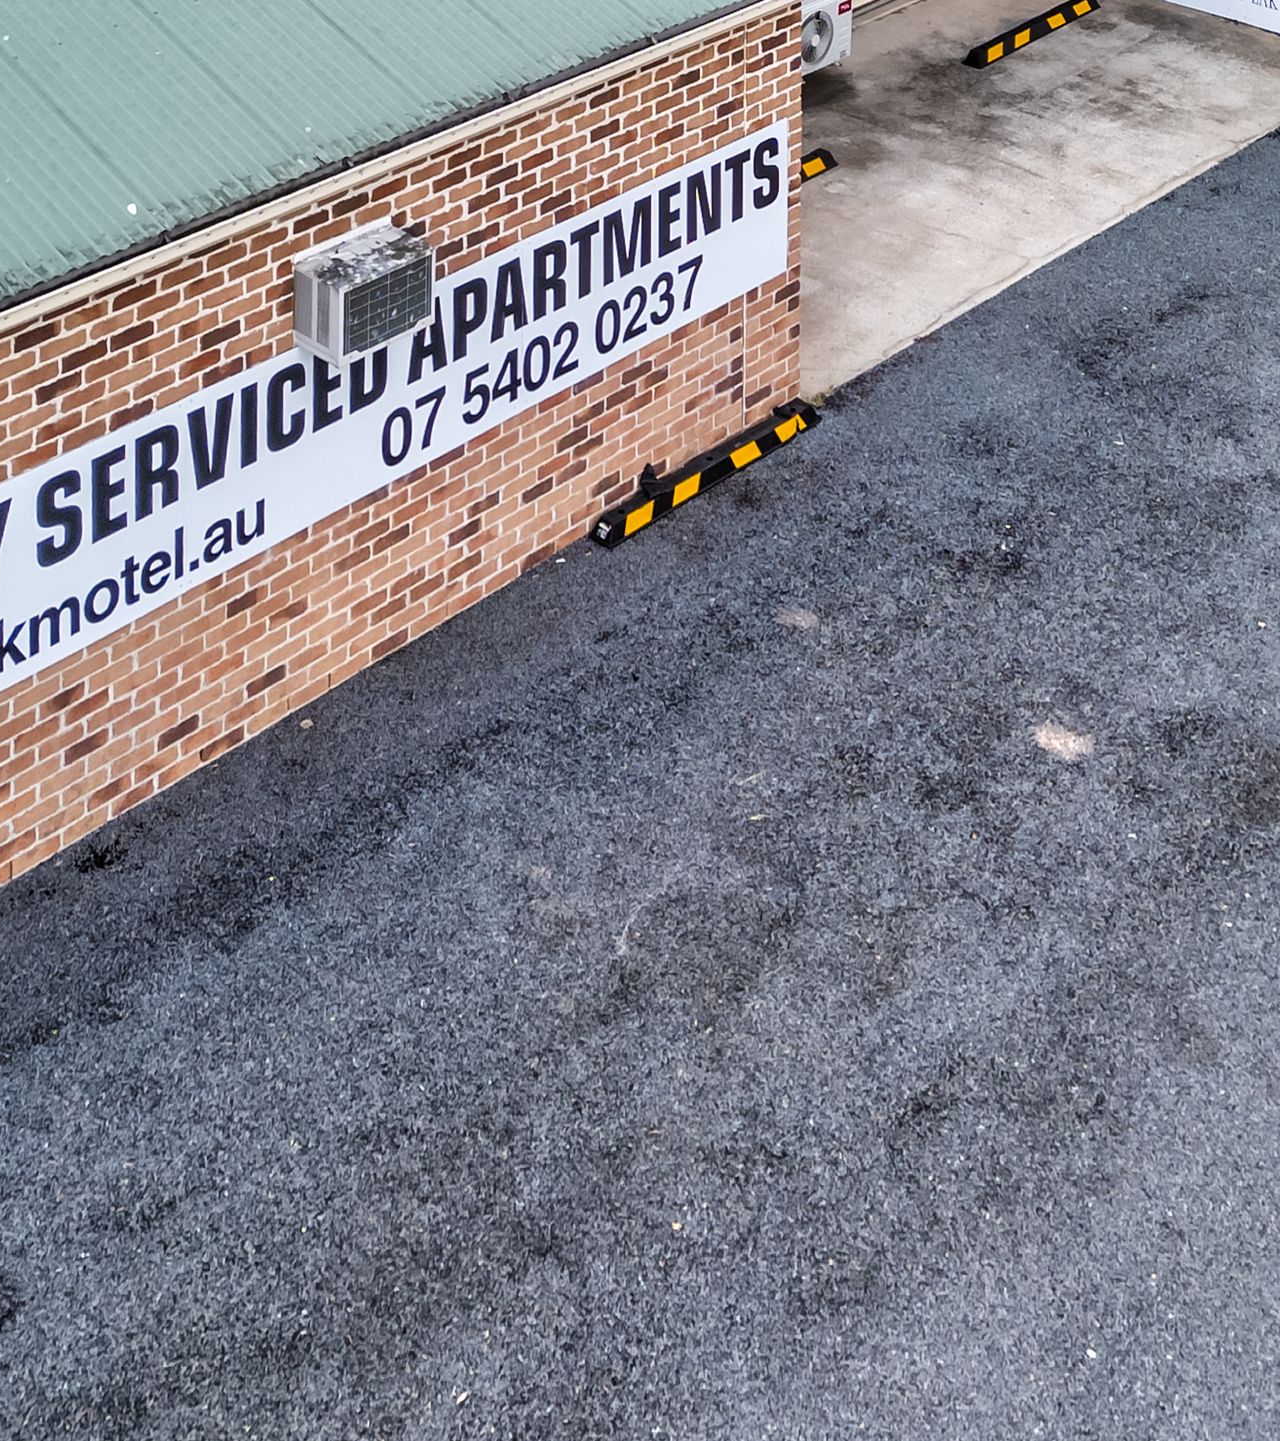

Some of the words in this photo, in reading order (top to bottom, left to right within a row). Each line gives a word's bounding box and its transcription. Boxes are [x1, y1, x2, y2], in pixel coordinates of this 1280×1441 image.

[37, 346, 388, 567] SERVICED
[406, 136, 781, 386] APARTMENTS
[381, 385, 447, 468] 07
[461, 321, 579, 426] 5402
[594, 254, 704, 356] 0237
